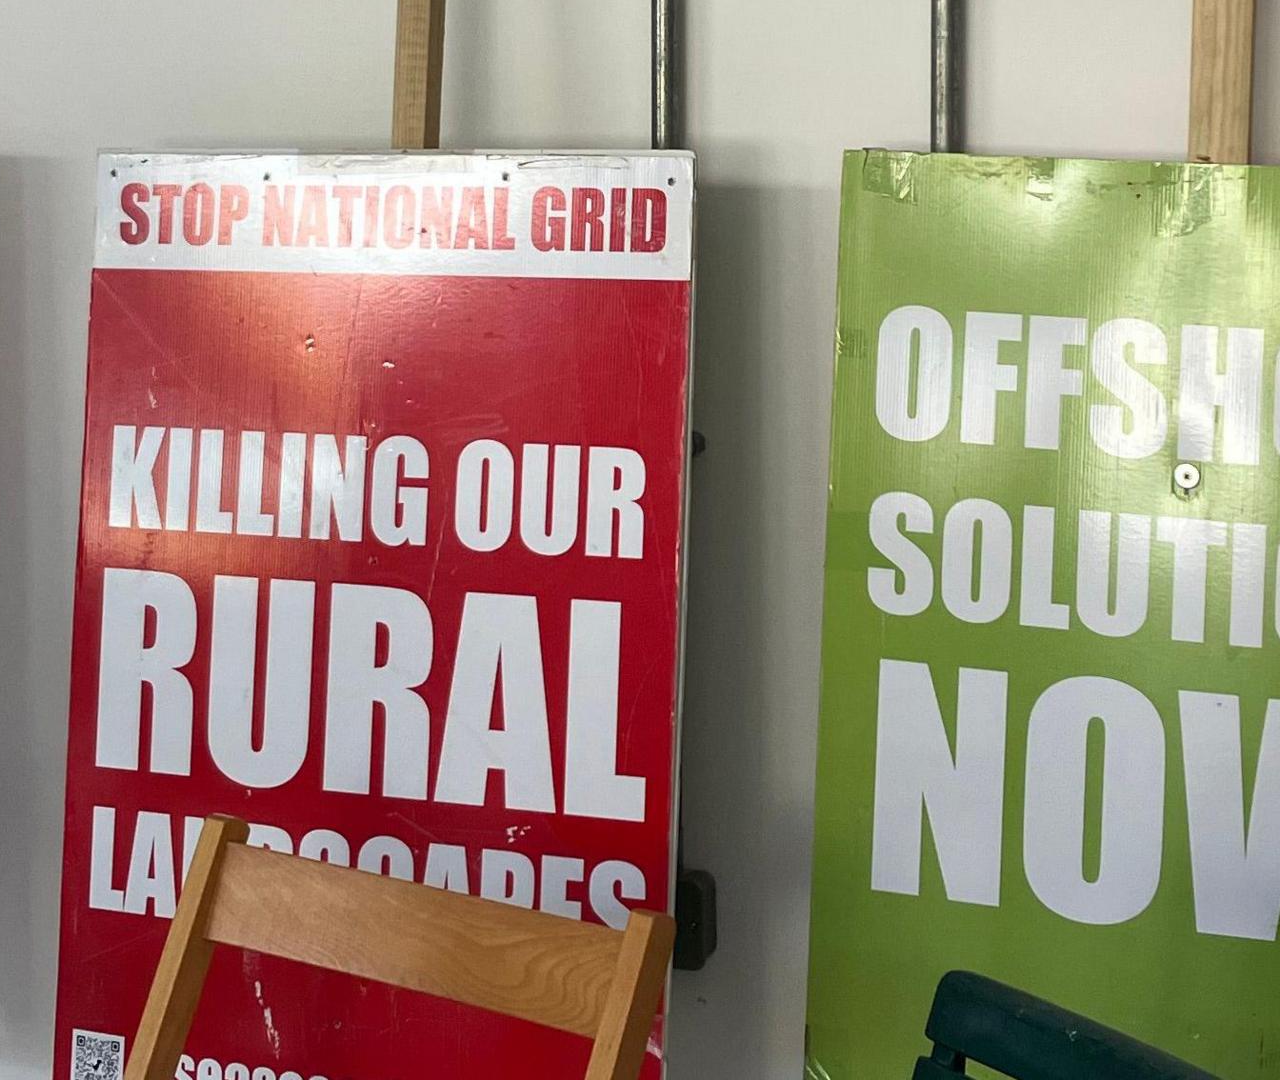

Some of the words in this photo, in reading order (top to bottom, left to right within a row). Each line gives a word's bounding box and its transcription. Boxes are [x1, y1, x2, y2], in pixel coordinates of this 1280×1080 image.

[120, 182, 250, 247] STOP
[262, 183, 516, 251] NATIONAL
[530, 185, 668, 254] GRID
[108, 424, 430, 548] KILLING
[453, 437, 646, 560] OUR
[95, 566, 647, 823] RURAL
